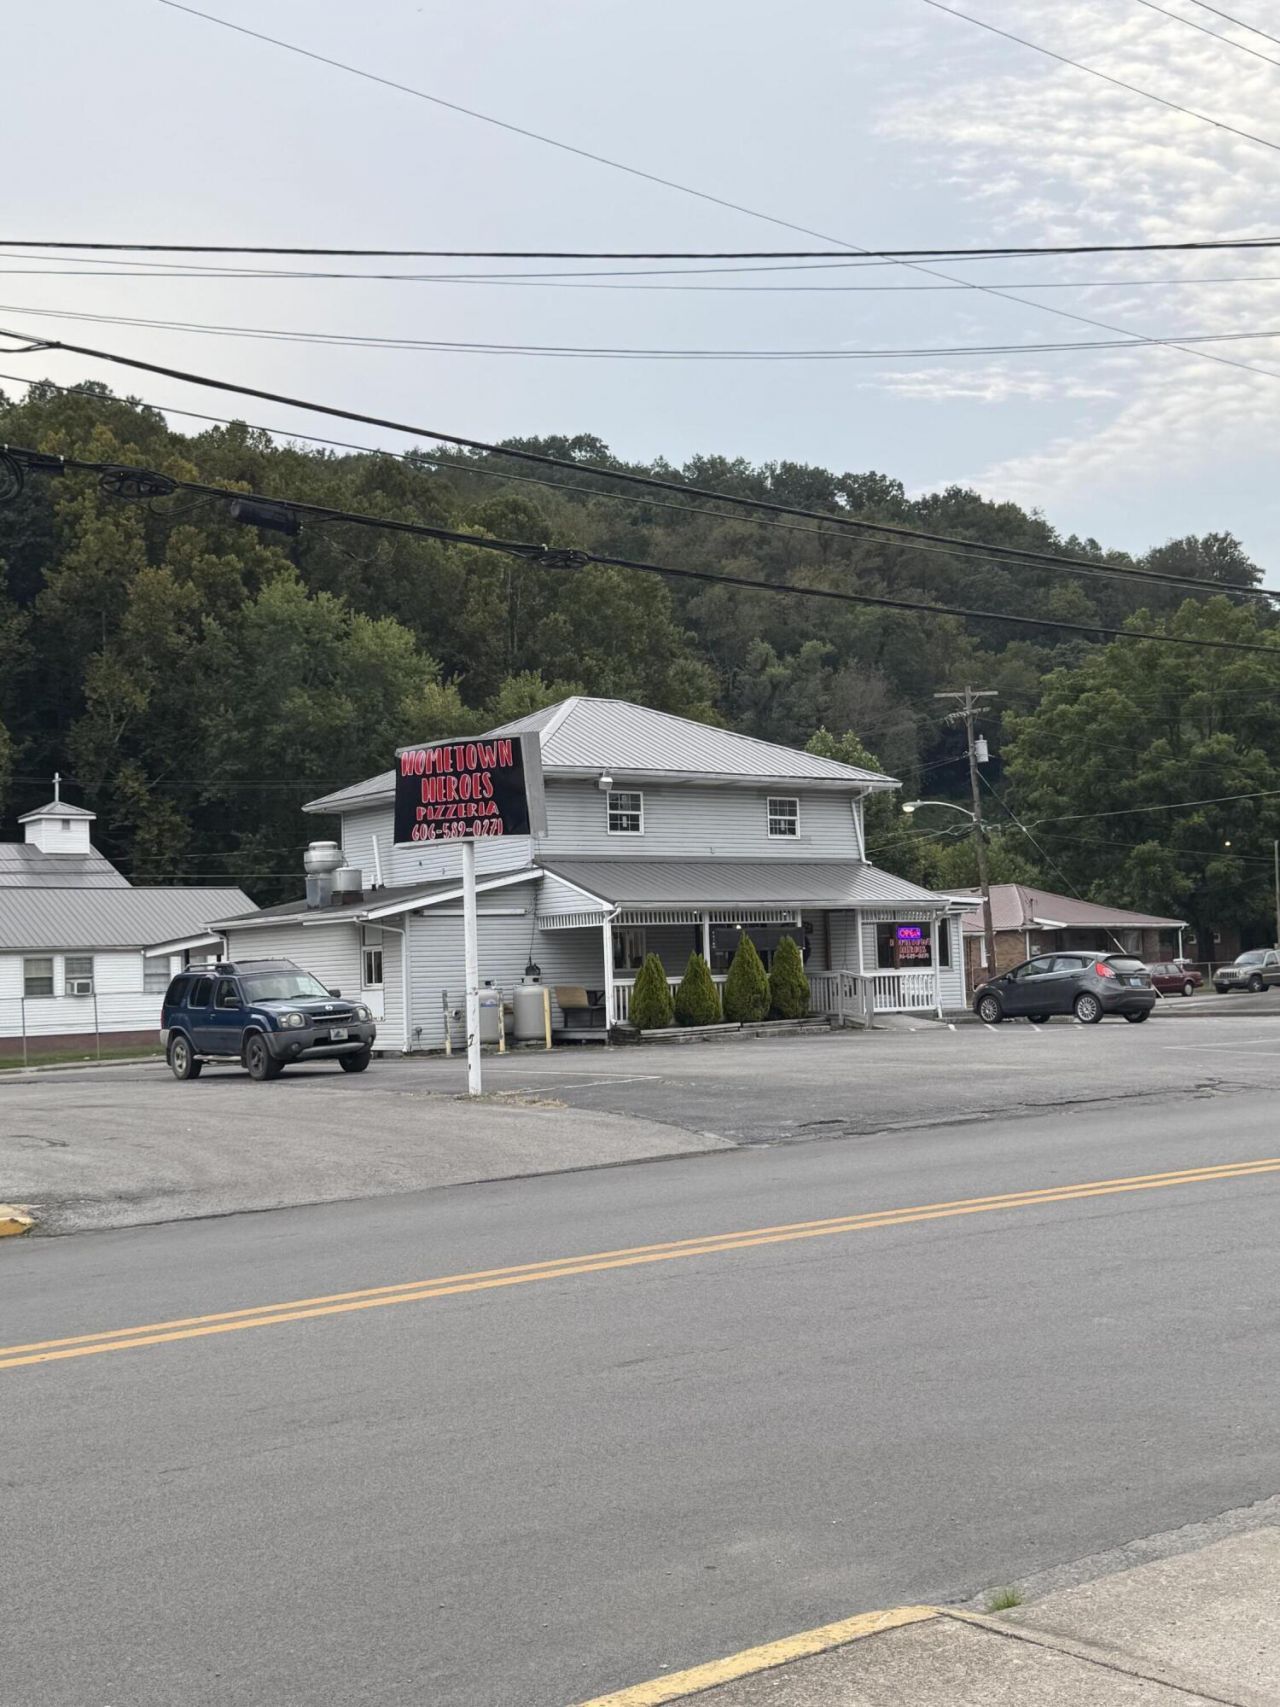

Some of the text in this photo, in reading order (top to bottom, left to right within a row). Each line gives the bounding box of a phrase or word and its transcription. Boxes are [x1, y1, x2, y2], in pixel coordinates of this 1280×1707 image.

[401, 739, 513, 776] HOMETOWN
[421, 772, 494, 803] HEROES
[416, 801, 499, 821] PIZZERIA
